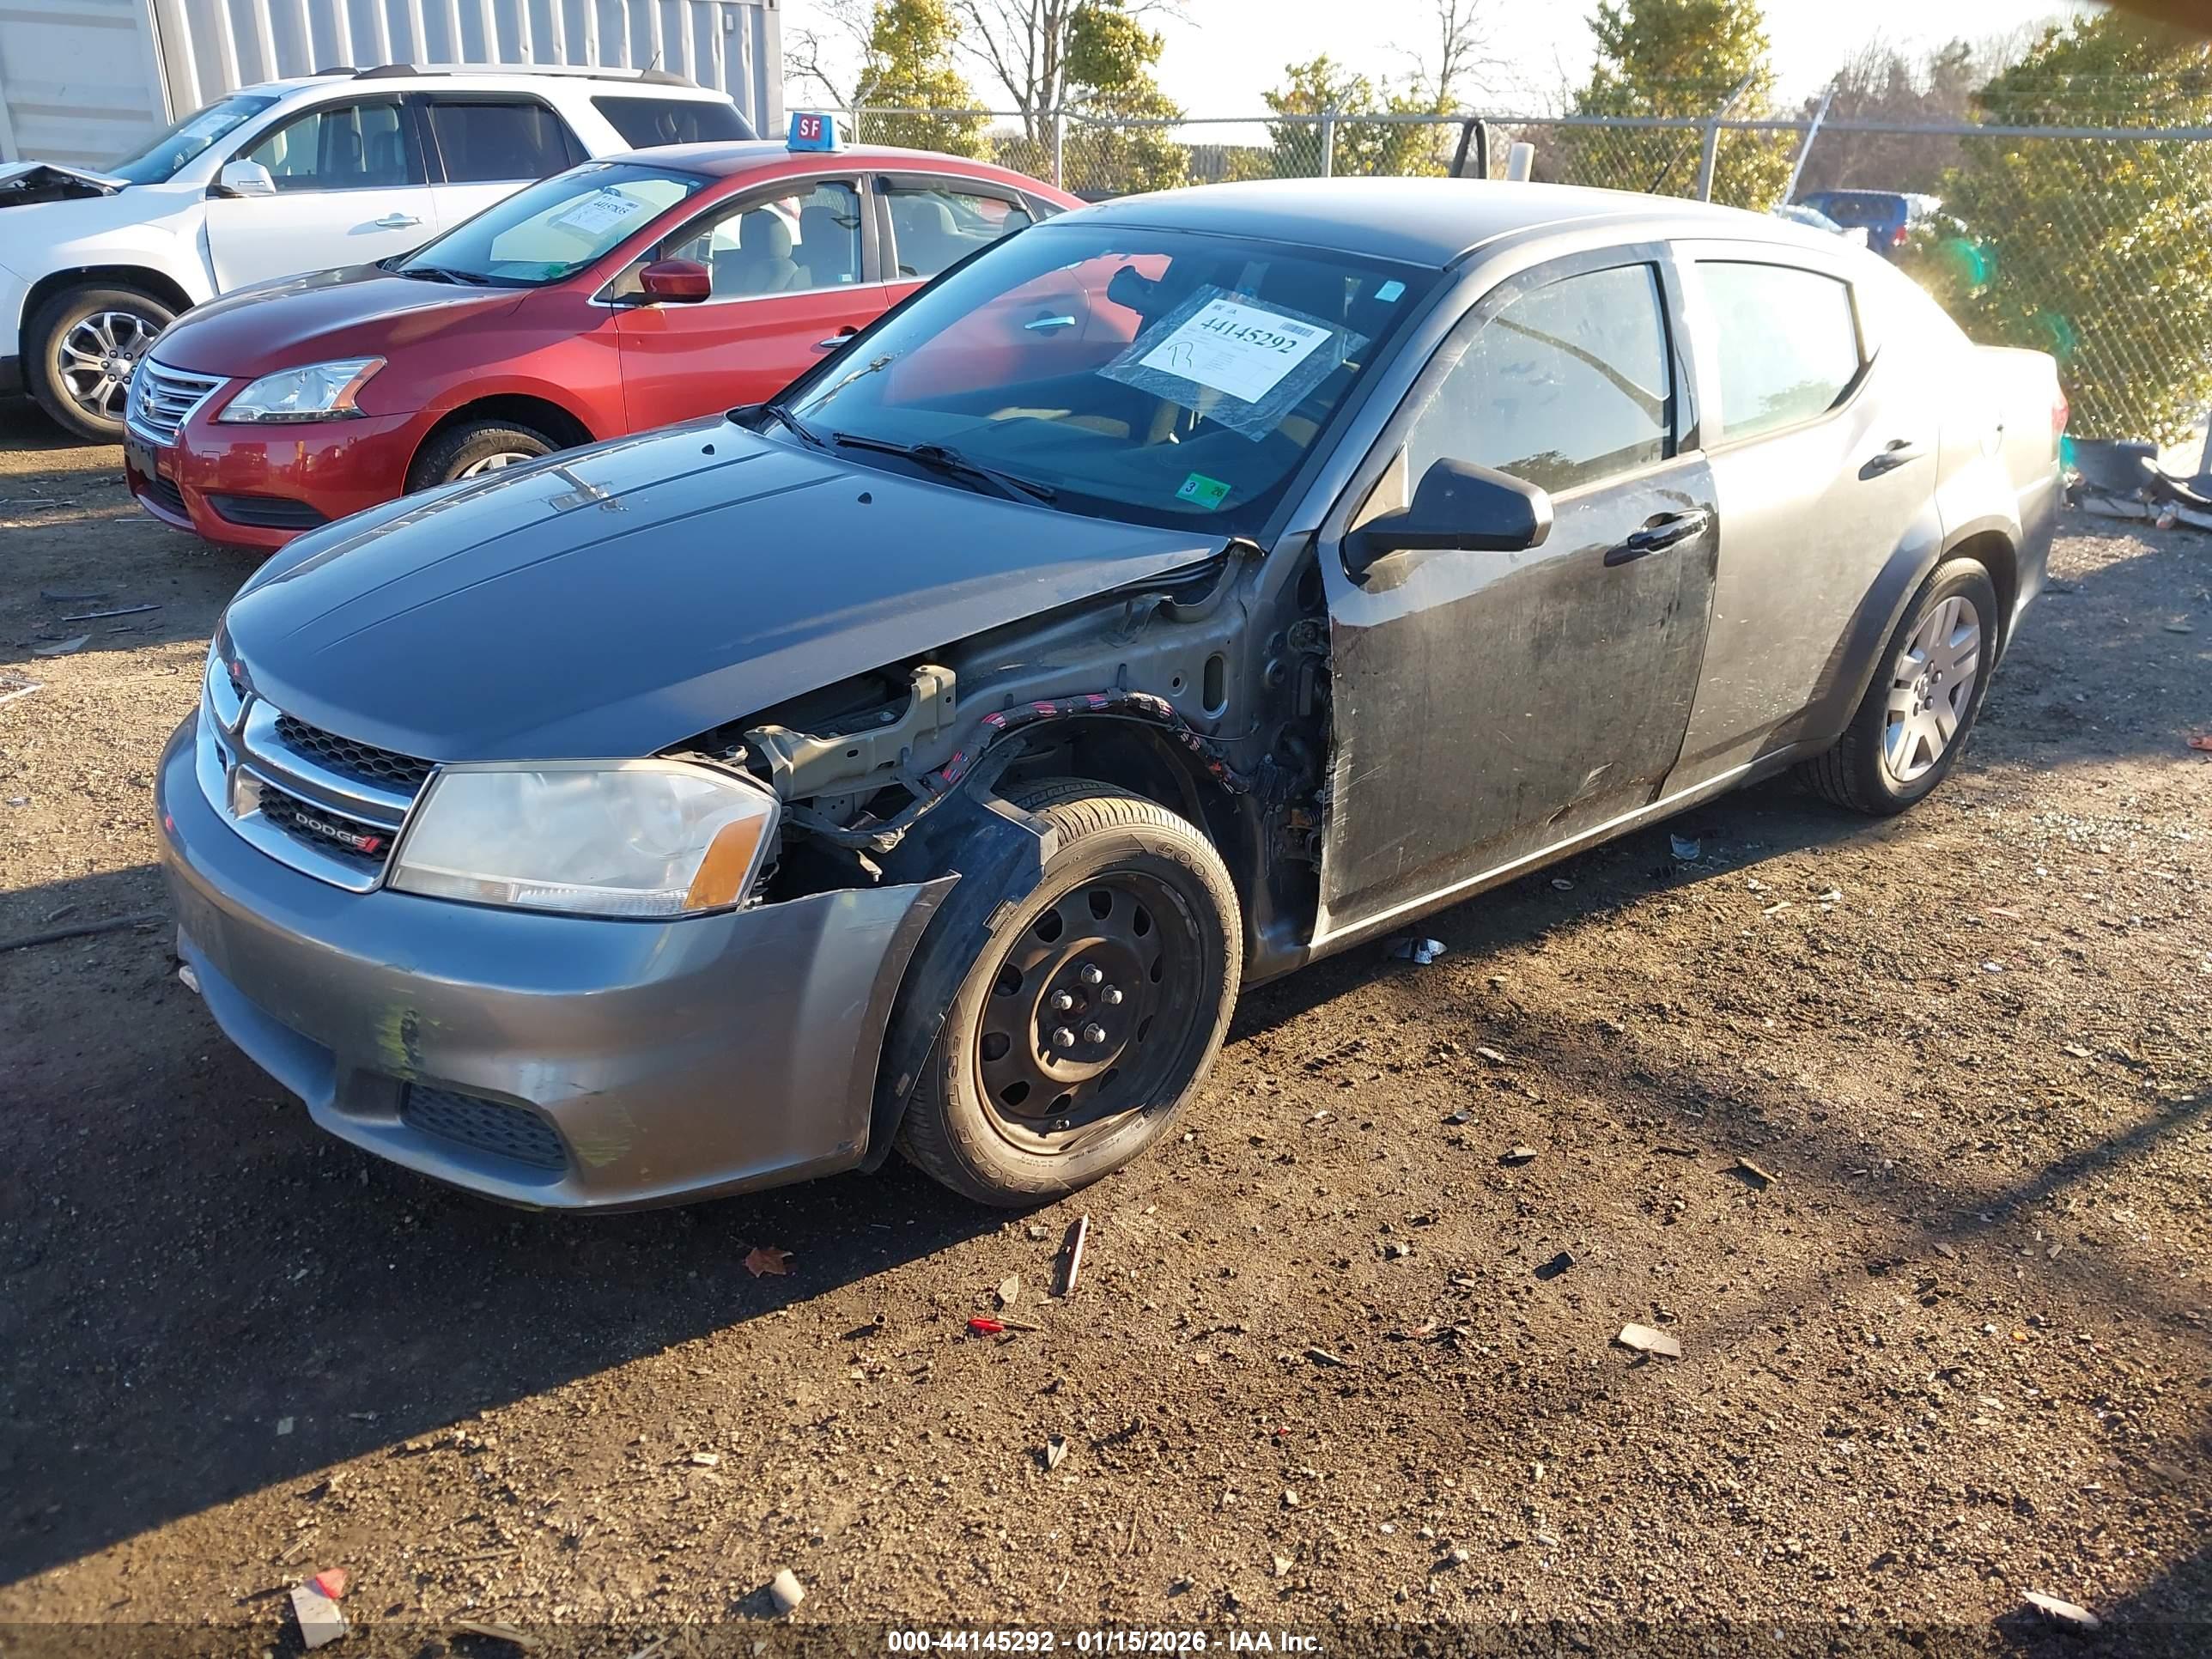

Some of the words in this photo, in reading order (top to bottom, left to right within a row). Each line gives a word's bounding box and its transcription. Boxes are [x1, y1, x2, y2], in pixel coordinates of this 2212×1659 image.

[1200, 317, 1298, 354] 44145292
[1185, 481, 1196, 493] 3
[1211, 486, 1225, 498] 26
[295, 812, 367, 848] DODGE
[1155, 841, 1233, 998] GOODYEAR
[955, 1125, 1046, 1194] EAGLE
